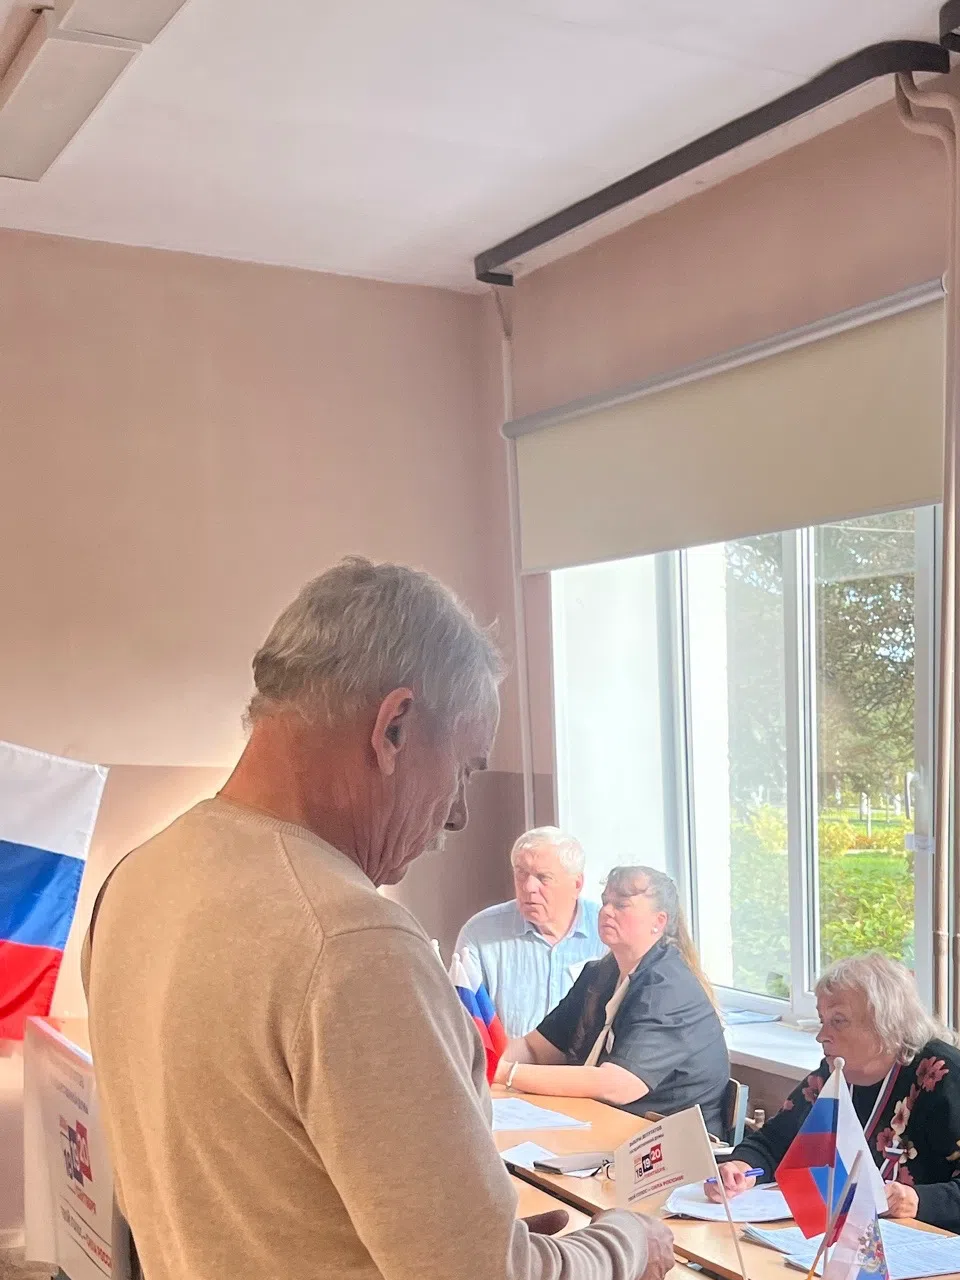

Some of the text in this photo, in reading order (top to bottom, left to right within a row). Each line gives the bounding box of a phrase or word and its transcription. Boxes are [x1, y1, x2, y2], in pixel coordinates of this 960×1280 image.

[635, 1167, 644, 1178] 18
[643, 1157, 651, 1170] 19
[650, 1148, 661, 1161] 20
